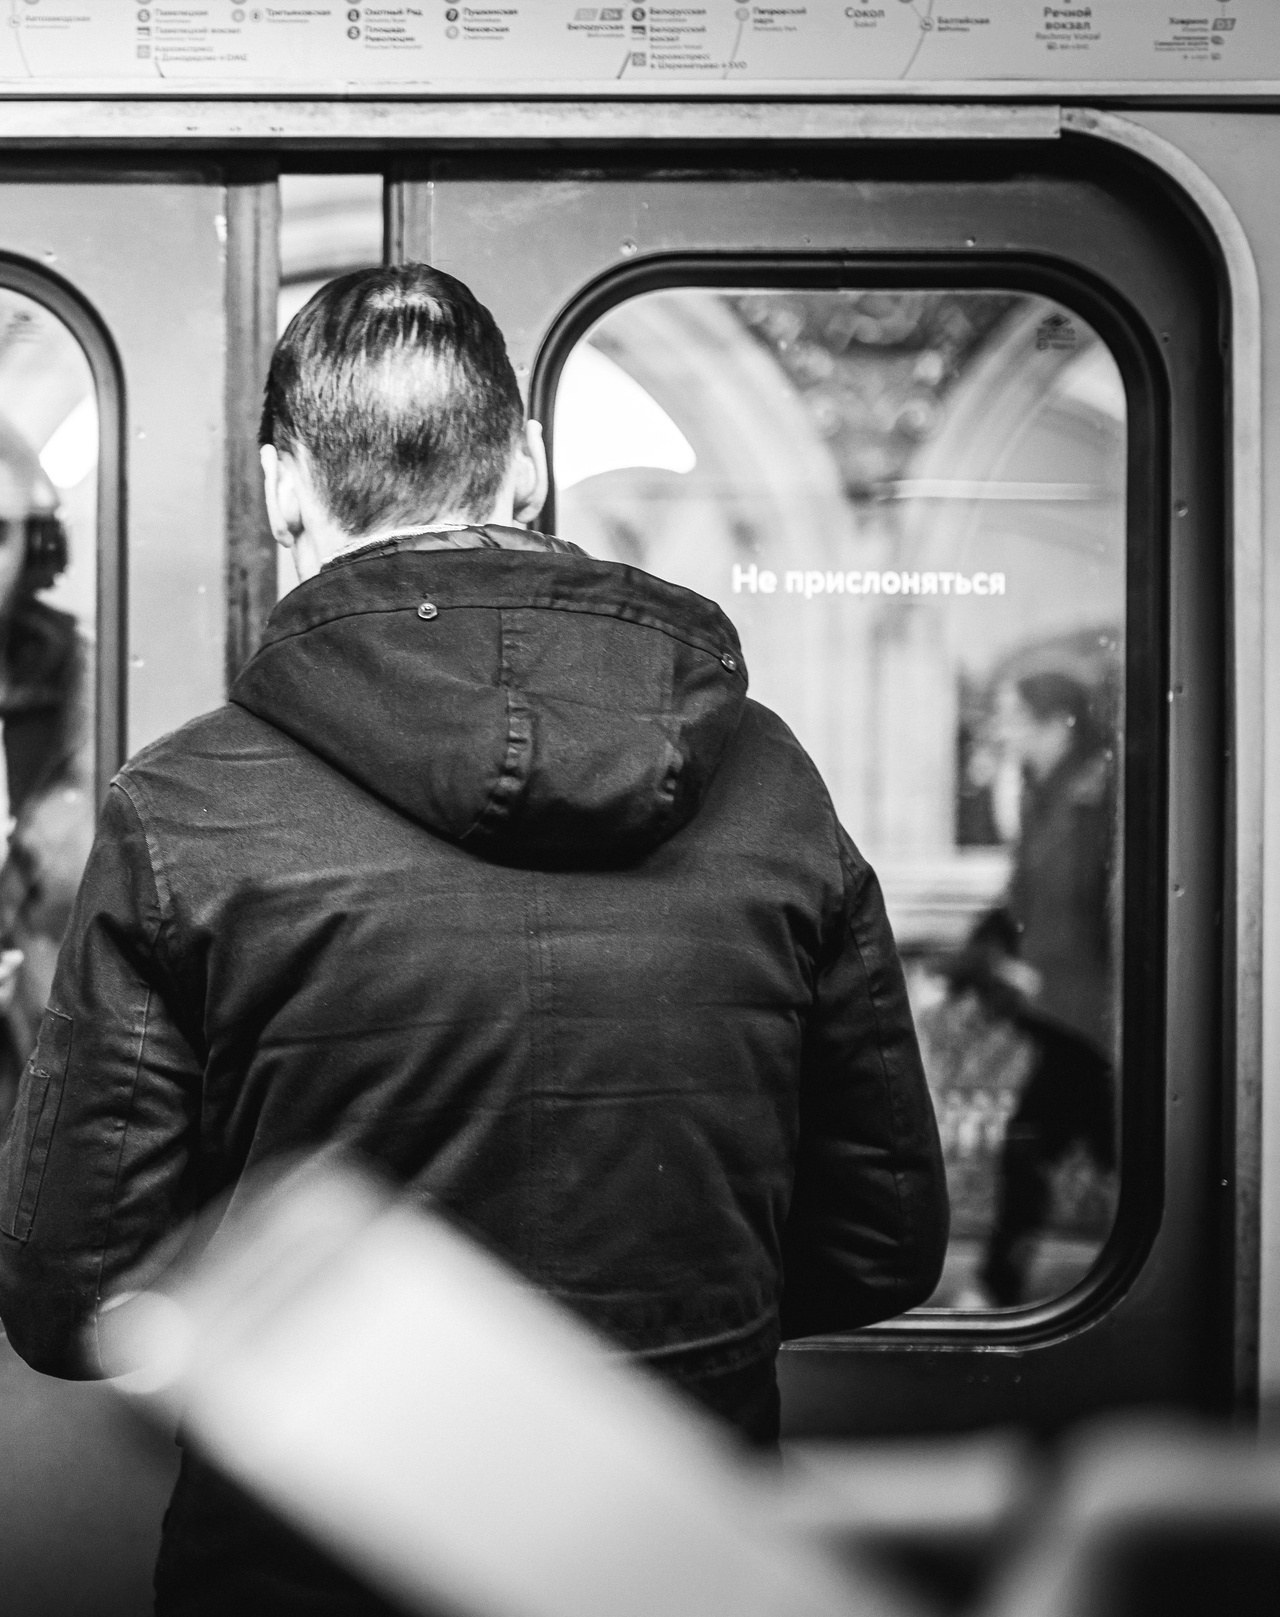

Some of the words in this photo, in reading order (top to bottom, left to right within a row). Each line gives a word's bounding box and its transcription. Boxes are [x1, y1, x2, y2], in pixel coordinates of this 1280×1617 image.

[843, 6, 886, 19] Сокол
[1043, 6, 1093, 19] Речной
[1044, 21, 1092, 31] вокзал
[731, 562, 778, 595] Не
[784, 569, 1006, 601] прислоняться
